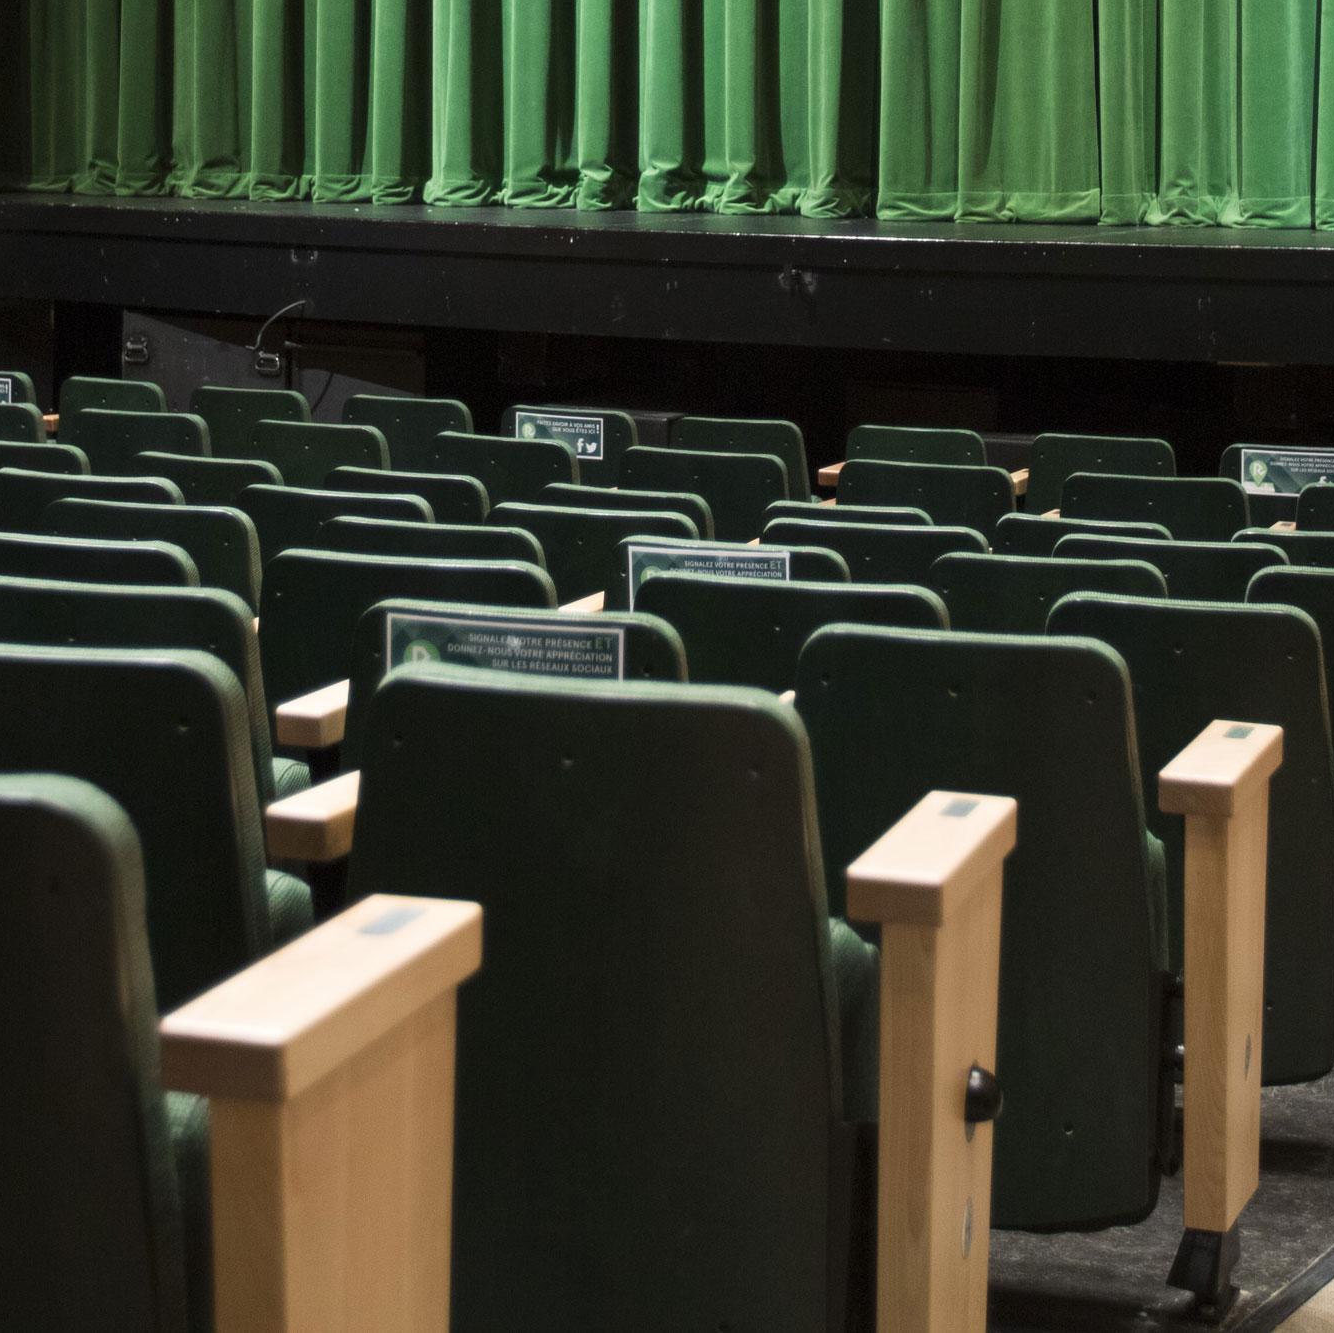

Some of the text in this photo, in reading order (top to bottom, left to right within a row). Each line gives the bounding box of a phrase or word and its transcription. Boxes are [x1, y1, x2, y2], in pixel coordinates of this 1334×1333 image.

[770, 561, 782, 570] ET
[595, 636, 612, 650] ET
[492, 658, 510, 669] SUR
[511, 660, 527, 670] LES
[572, 663, 613, 675] SOCIAUX
